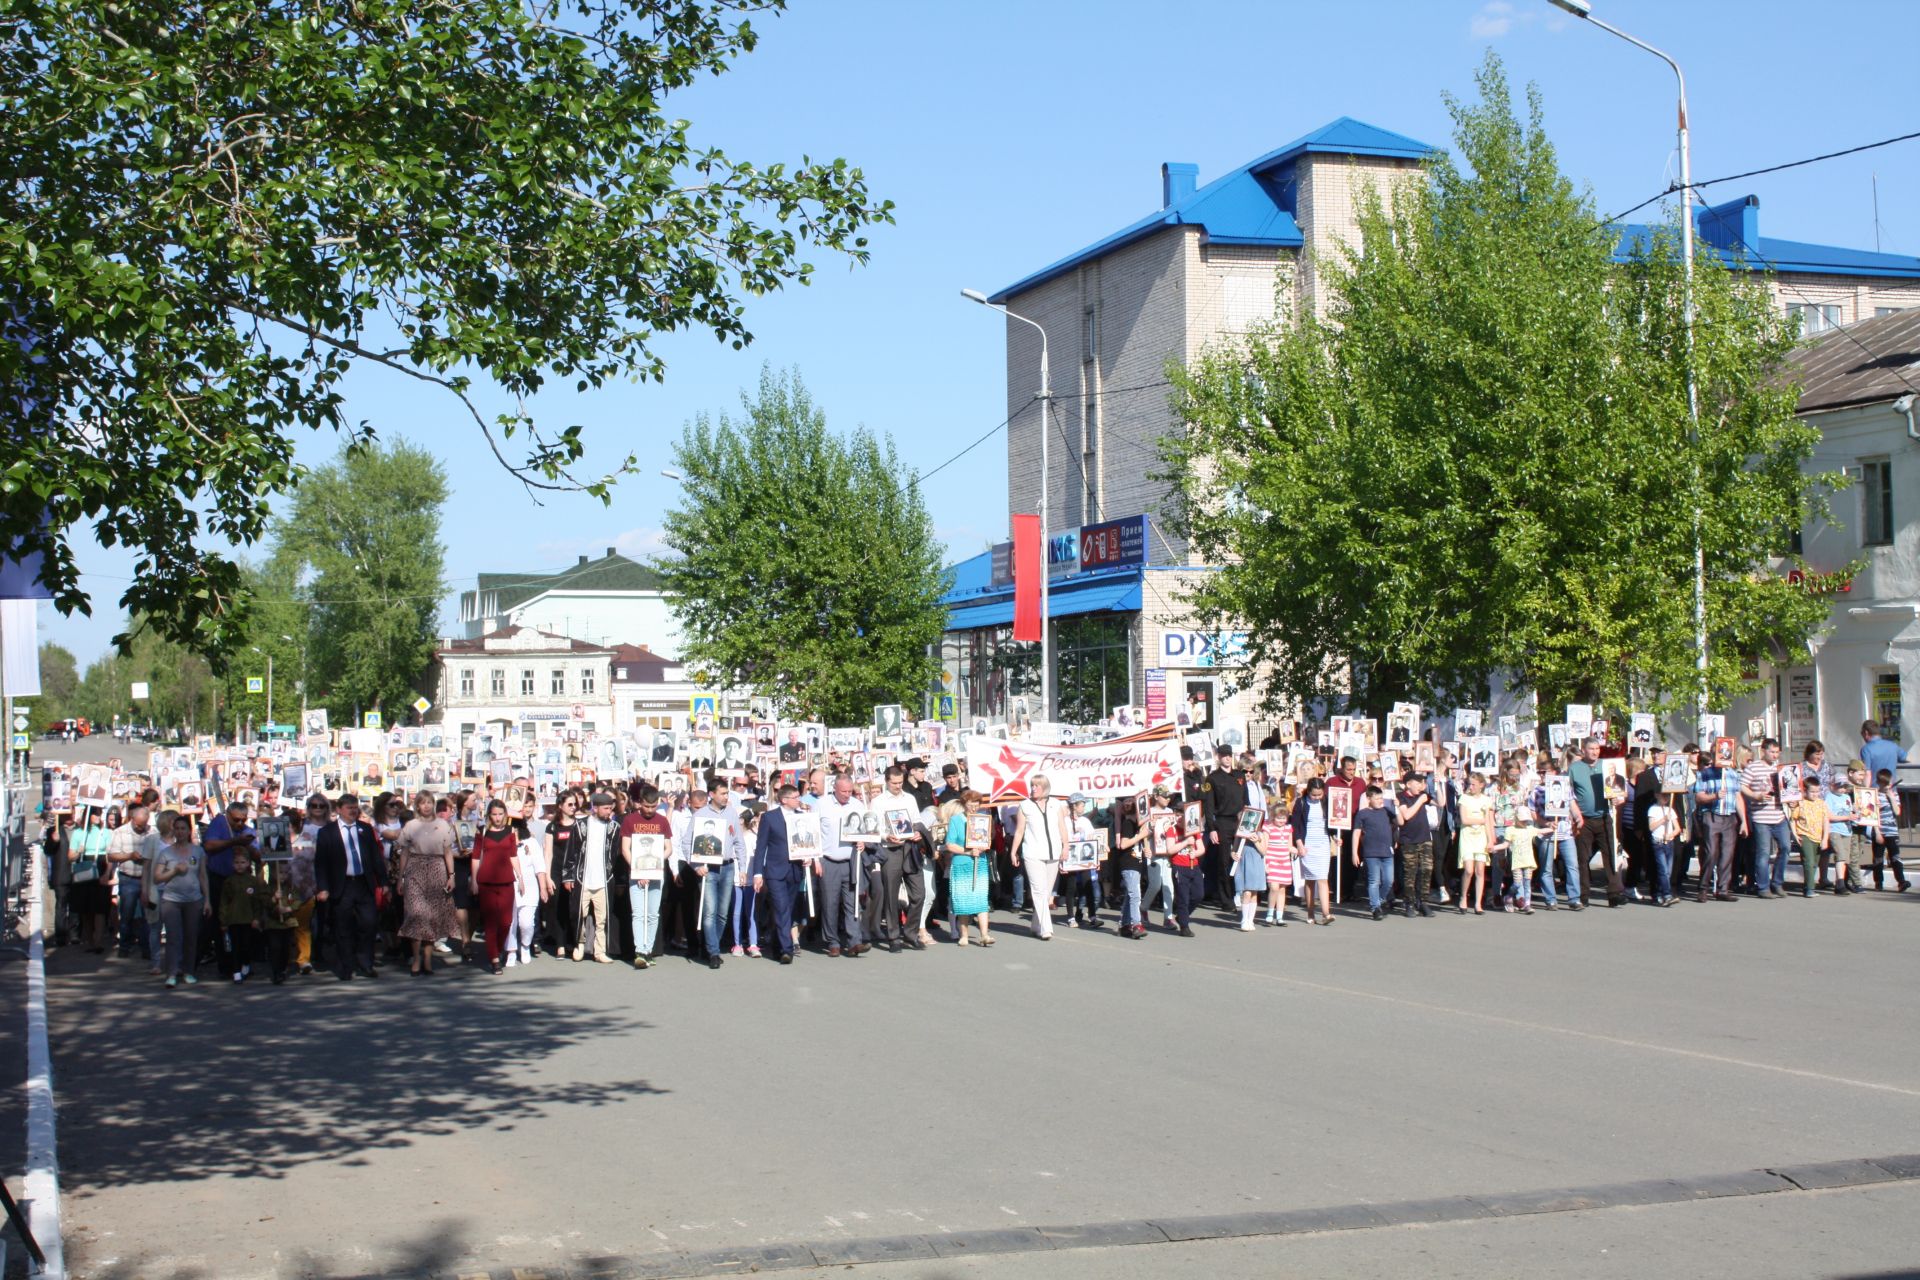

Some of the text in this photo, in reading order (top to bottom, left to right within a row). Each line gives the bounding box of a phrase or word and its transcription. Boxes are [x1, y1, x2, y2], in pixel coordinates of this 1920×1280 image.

[1165, 633, 1250, 656] DIXIS
[1039, 744, 1167, 771] Бессмертный
[1078, 773, 1135, 790] ПОЛК
[633, 823, 661, 832] UPSIDE
